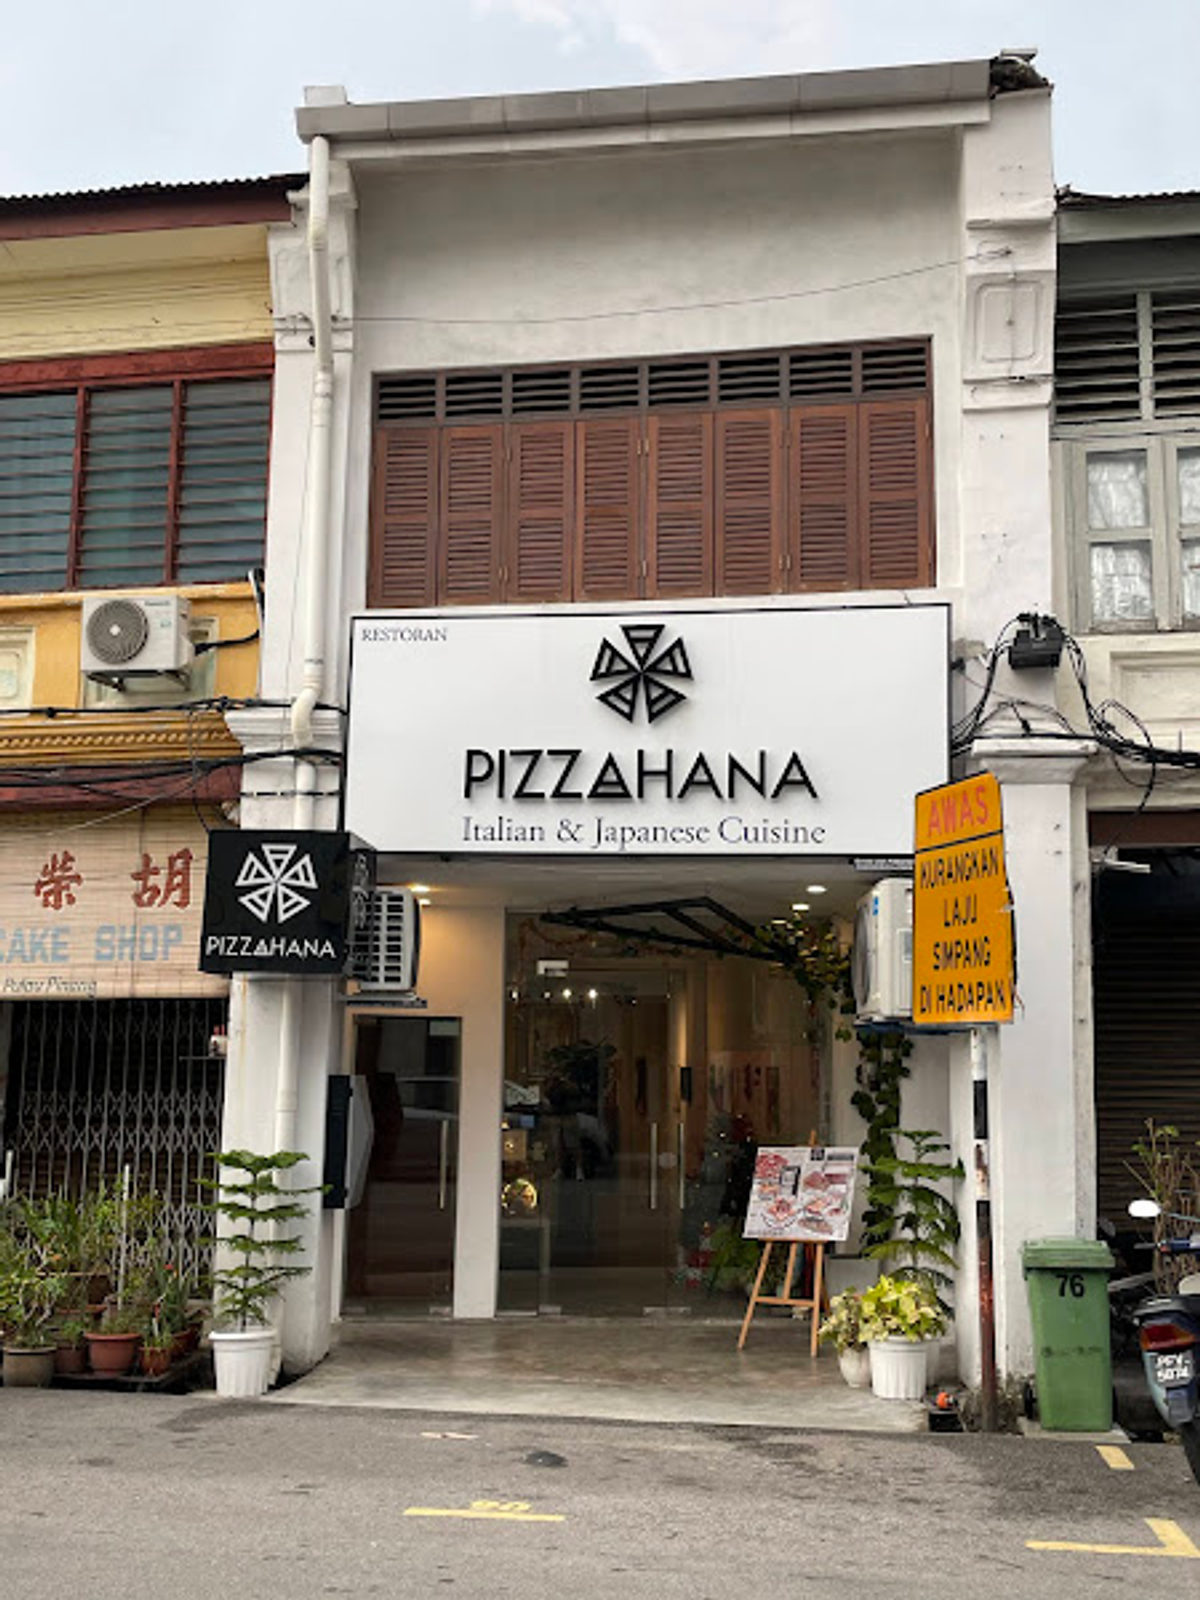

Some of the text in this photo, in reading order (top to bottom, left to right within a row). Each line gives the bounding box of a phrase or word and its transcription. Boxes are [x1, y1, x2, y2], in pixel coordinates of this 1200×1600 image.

[361, 627, 447, 642] RESTORAN
[464, 749, 819, 800] PIZZAHANA
[928, 785, 990, 837] AWAS
[462, 816, 825, 851] Italian & Japanese Cuisine
[920, 846, 999, 889] KURANGKAN
[944, 893, 978, 928] LAJU
[95, 925, 183, 962] SHOP
[206, 935, 337, 959] PIZZAHANA
[920, 980, 1006, 1014] DI HADAPAN
[1056, 1274, 1085, 1298] 76
